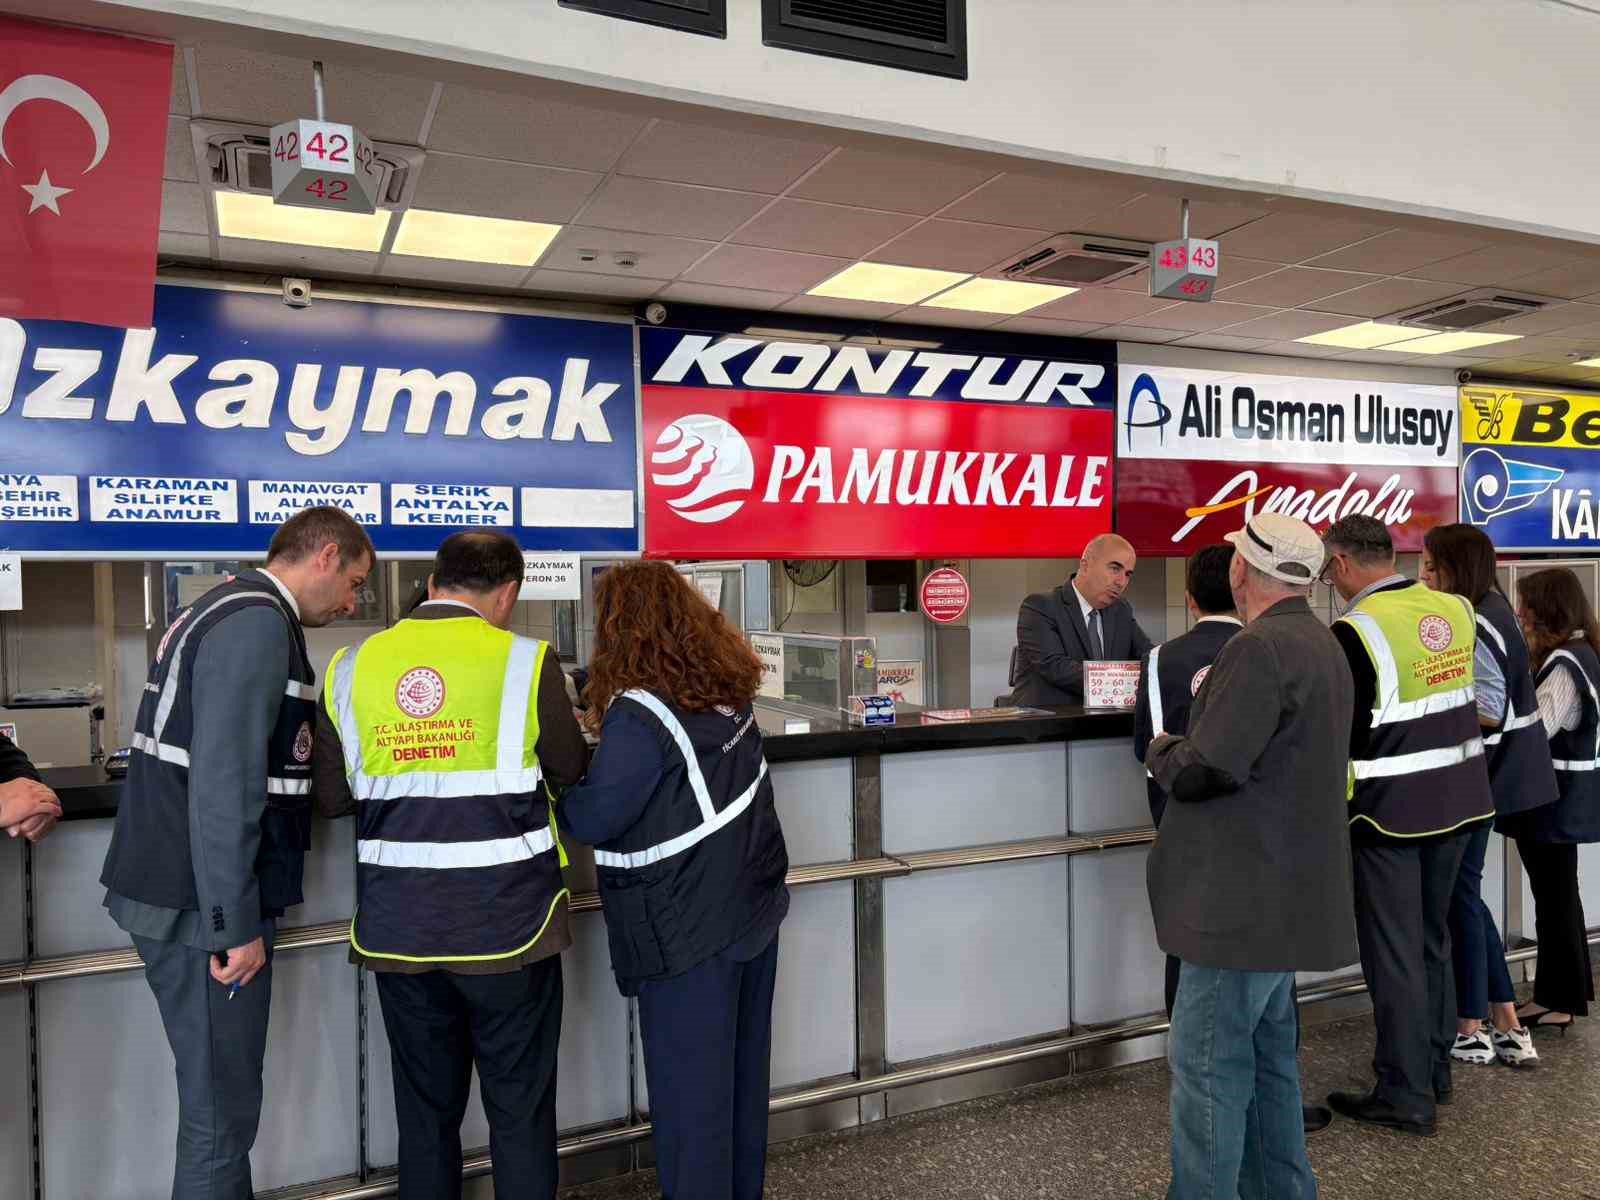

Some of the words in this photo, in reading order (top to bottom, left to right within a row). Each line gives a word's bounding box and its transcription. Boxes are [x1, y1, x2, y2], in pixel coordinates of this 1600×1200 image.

[275, 131, 298, 162] 42
[306, 132, 349, 162] 42
[305, 176, 348, 201] 42
[1159, 246, 1187, 269] 43
[1192, 247, 1216, 268] 43
[651, 334, 1105, 406] KONTUR
[1178, 384, 1222, 439] Ali
[1232, 386, 1345, 443] Osman
[1354, 394, 1453, 457] Ulusoy
[96, 478, 229, 491] KARAMAN
[762, 445, 1108, 508] PAMUKKALE
[262, 483, 368, 495] MANAVGAT
[394, 498, 509, 511] ANTALYA
[107, 508, 221, 520] ANAMUR
[408, 513, 497, 525] KEMER
[526, 561, 574, 569] ZKAYMAK
[525, 575, 552, 583] ERON
[395, 719, 456, 733] ULAŞTIRMA
[460, 719, 473, 729] VE
[376, 734, 415, 748] ALTYAPI
[417, 730, 475, 745] BAKANLIĞI
